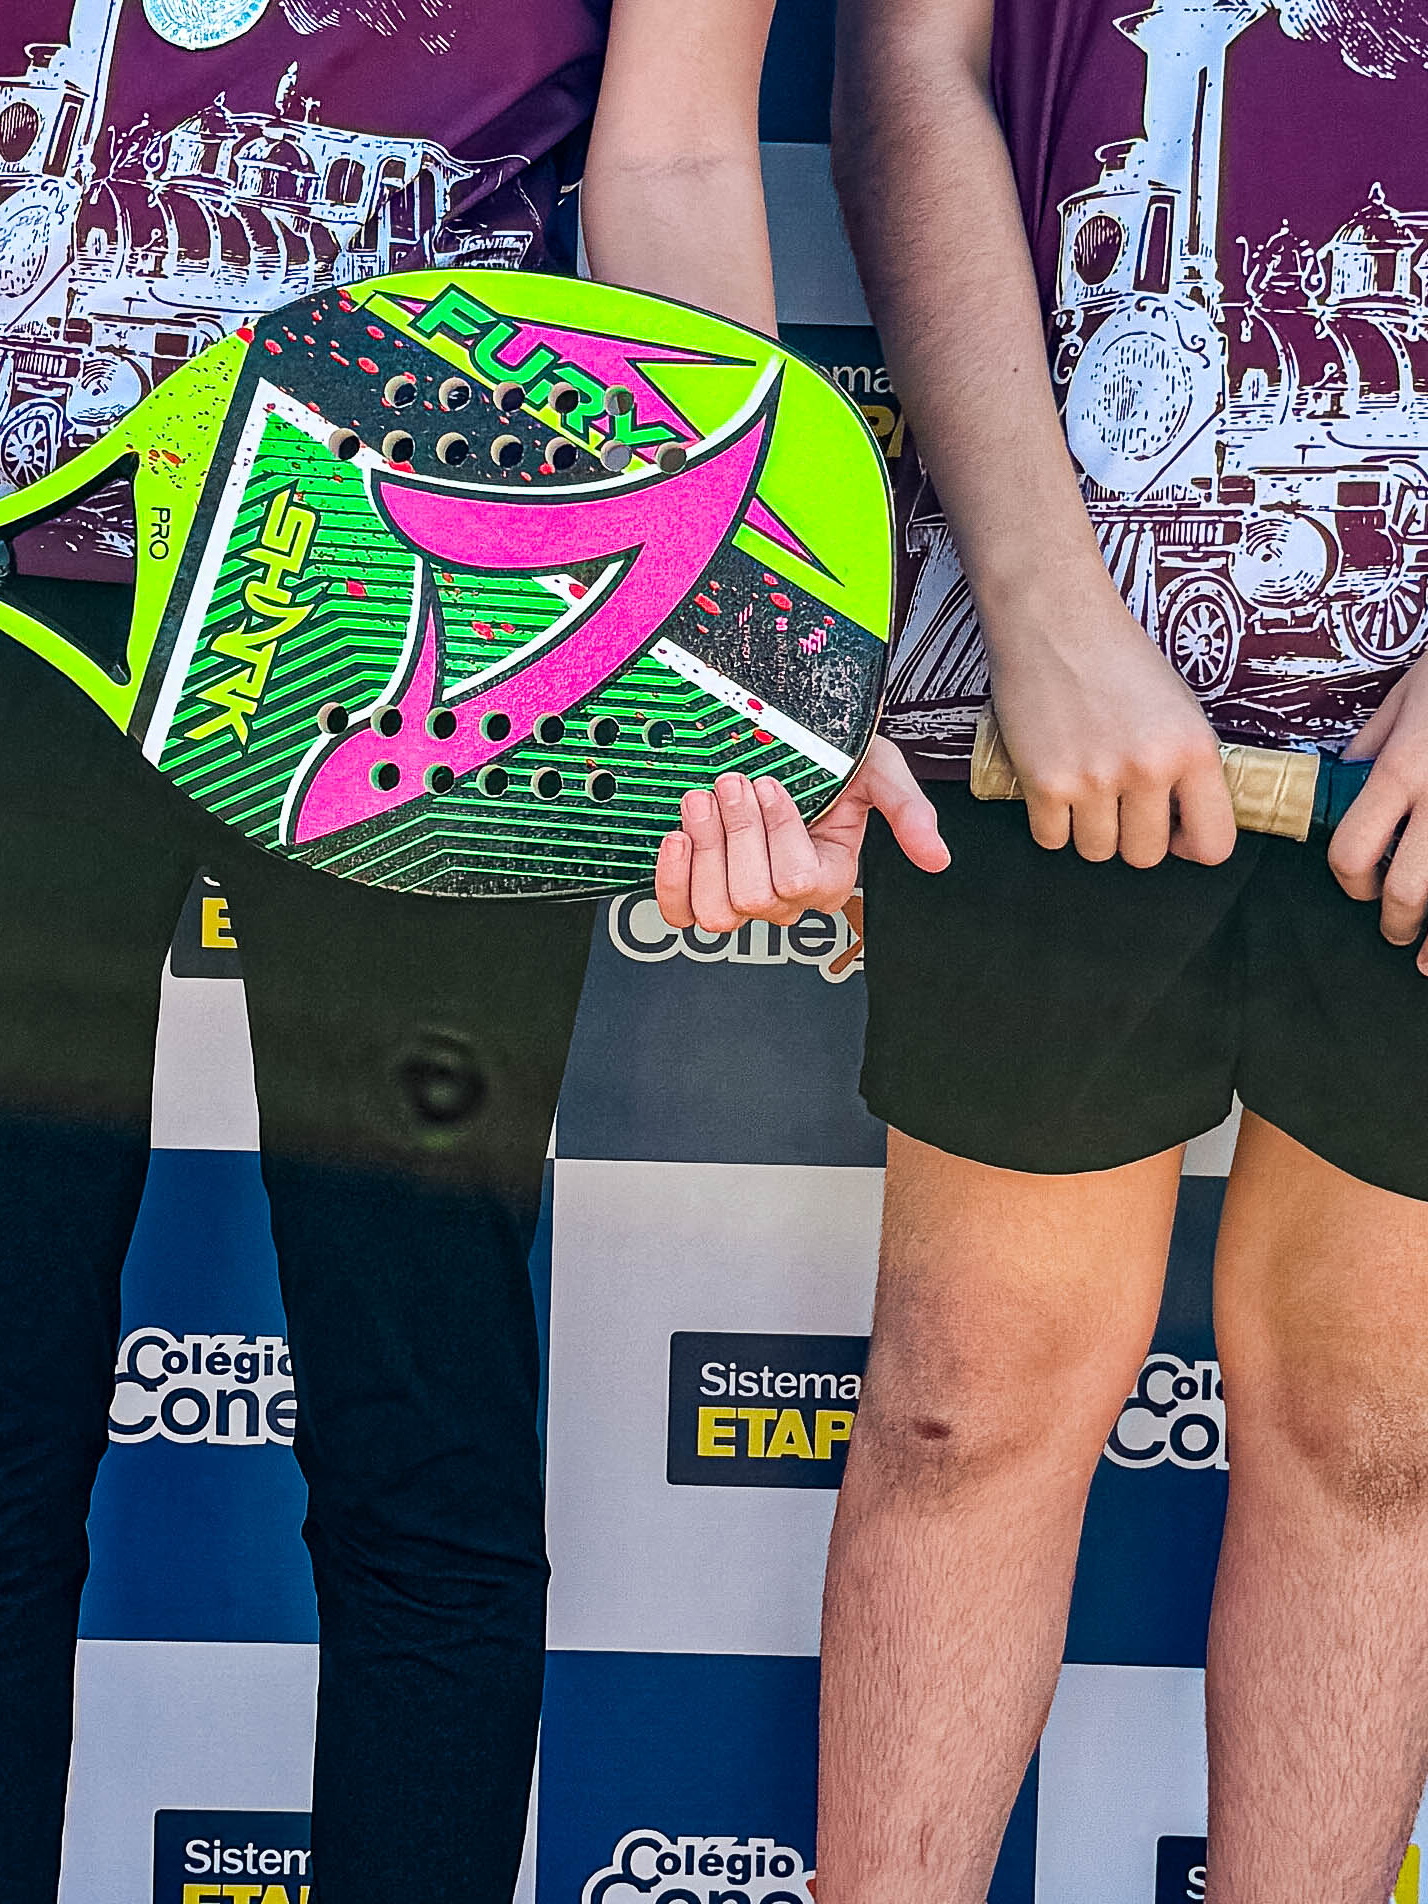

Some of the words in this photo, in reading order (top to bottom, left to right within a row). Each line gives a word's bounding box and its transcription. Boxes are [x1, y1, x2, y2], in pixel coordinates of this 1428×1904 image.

[410, 285, 678, 447] FURY
[148, 506, 171, 561] PRO
[183, 488, 317, 746] SHARK
[699, 1361, 861, 1400] Sistema
[696, 1406, 855, 1461] ETAP
[183, 1839, 311, 1876] Sistem
[621, 1837, 795, 1886] Colégio
